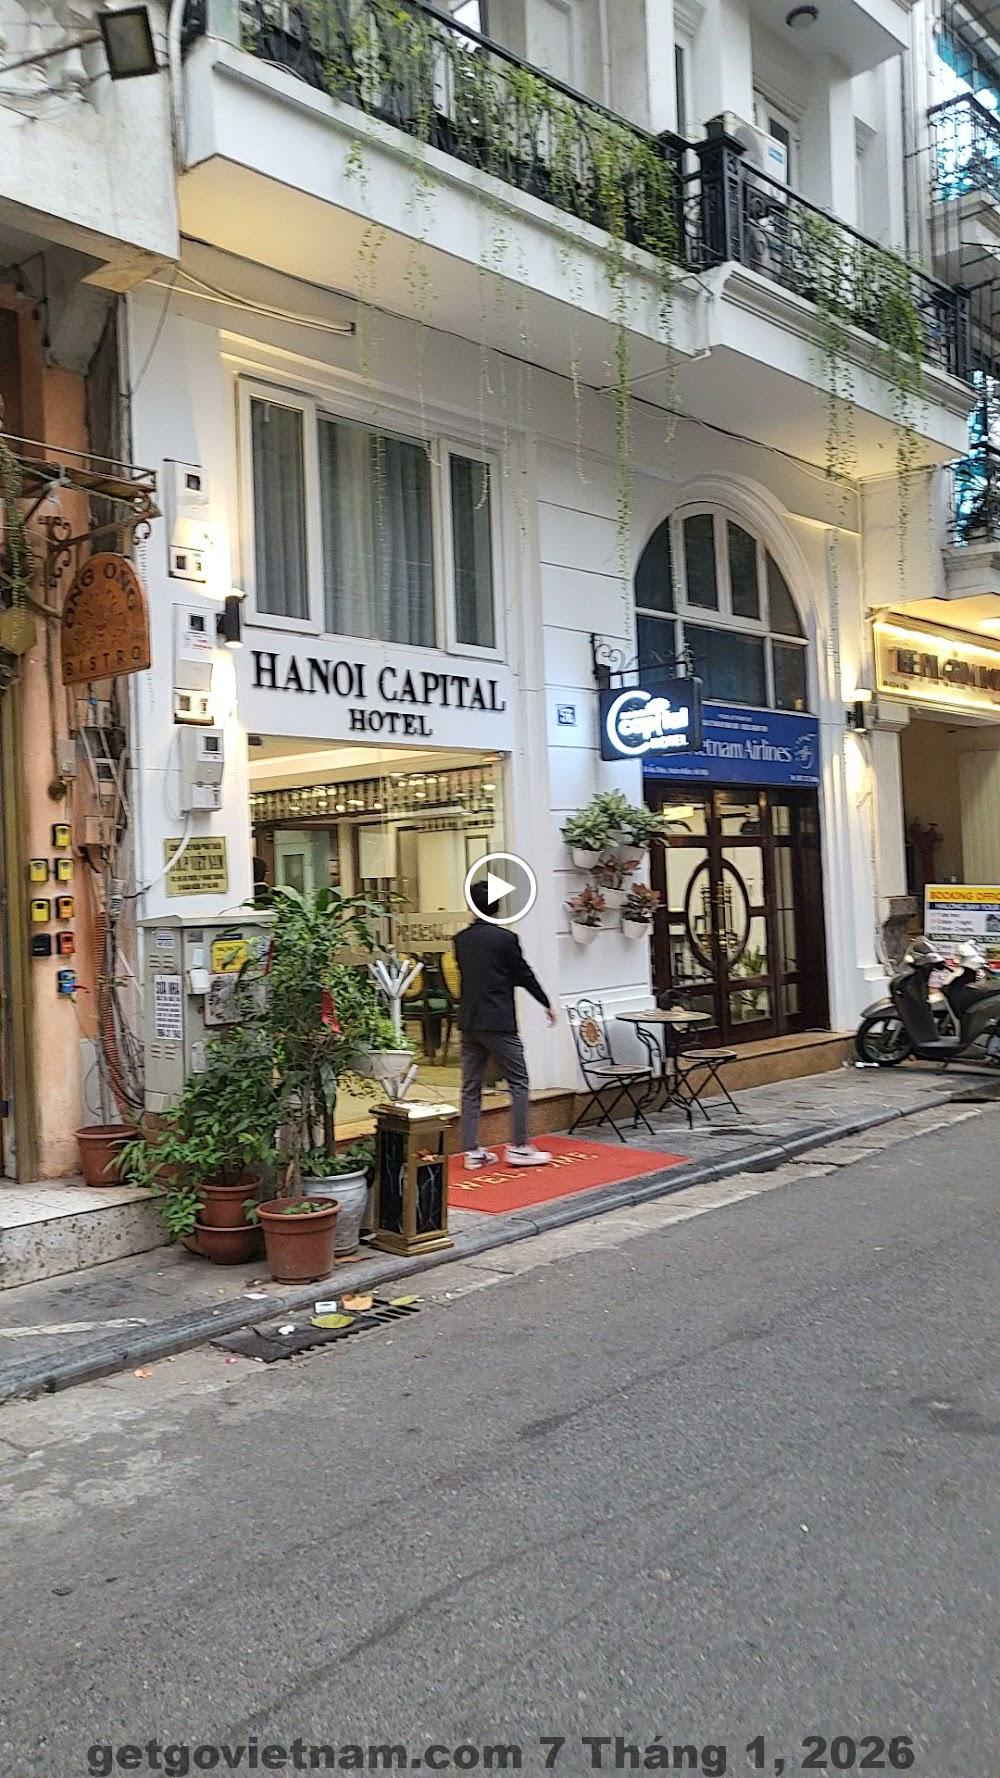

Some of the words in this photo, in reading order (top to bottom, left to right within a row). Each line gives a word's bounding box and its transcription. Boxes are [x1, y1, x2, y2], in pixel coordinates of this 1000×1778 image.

[63, 645, 142, 677] BISTRO
[250, 650, 367, 698] HANOI
[378, 666, 506, 712] CAPITAL
[348, 708, 433, 736] HOTEL
[745, 738, 792, 763] Airlines
